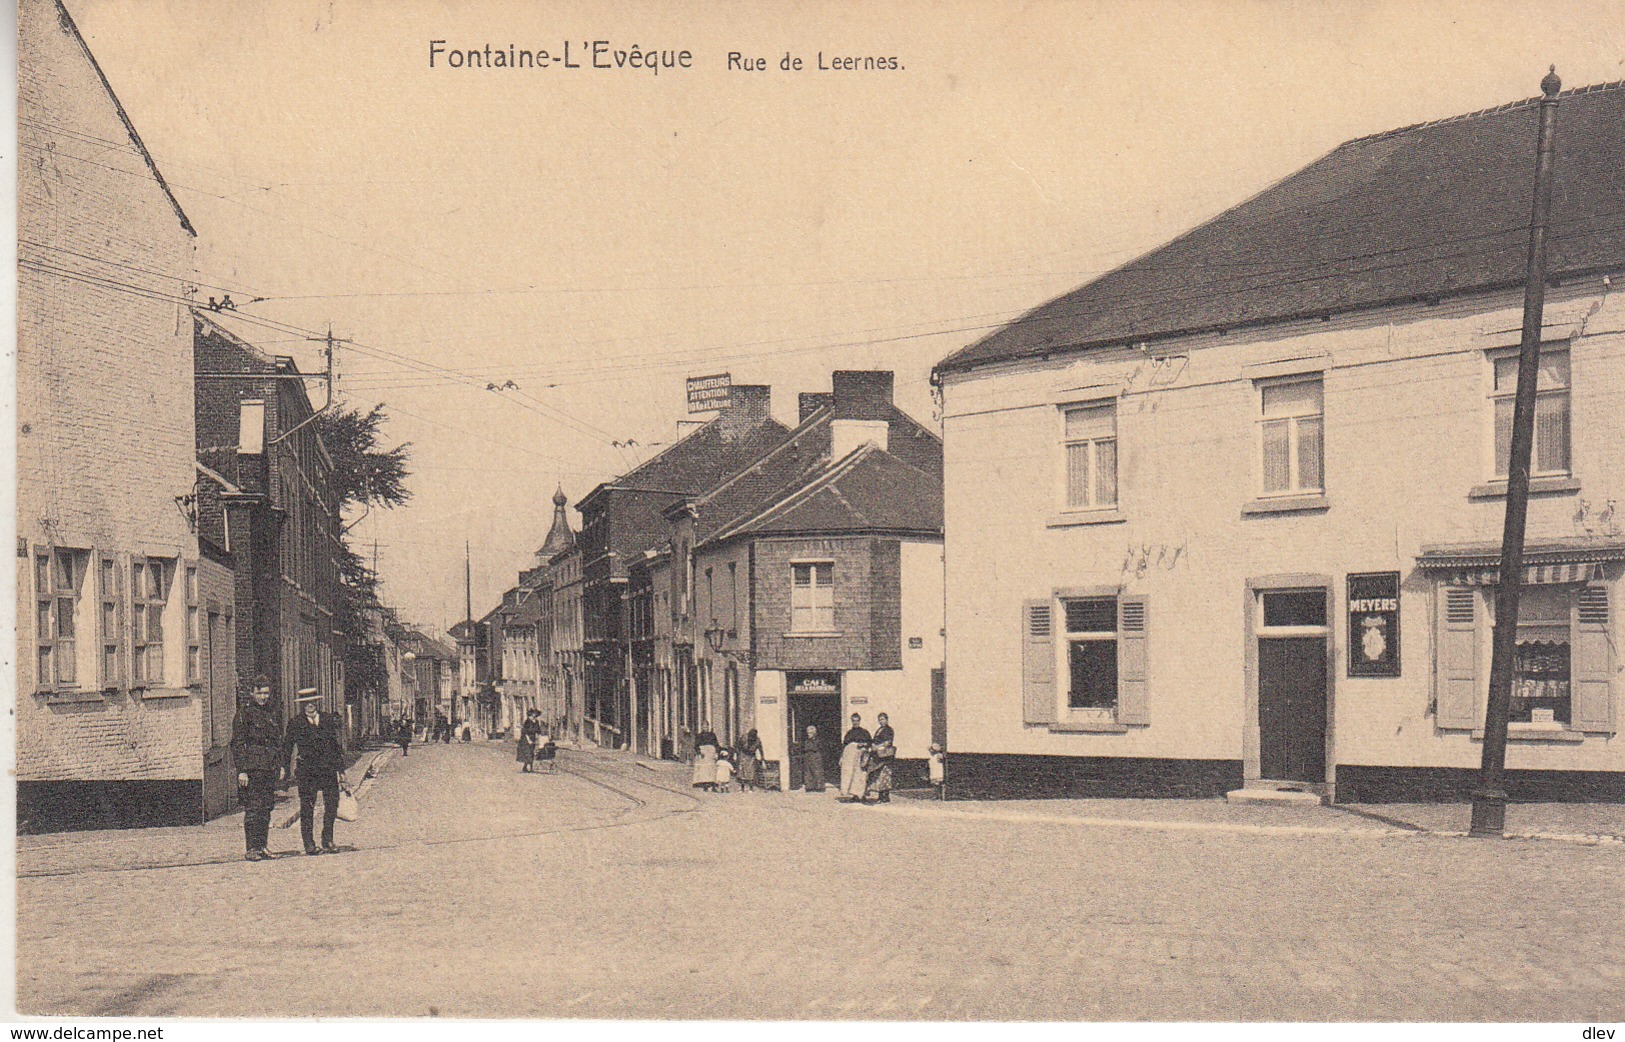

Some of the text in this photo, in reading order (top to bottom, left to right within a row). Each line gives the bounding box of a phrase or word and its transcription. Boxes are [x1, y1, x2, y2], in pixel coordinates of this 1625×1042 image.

[687, 377, 730, 391] CHAUFFEURS
[690, 388, 728, 401] ATTENTION
[1350, 598, 1397, 612] MEYERS
